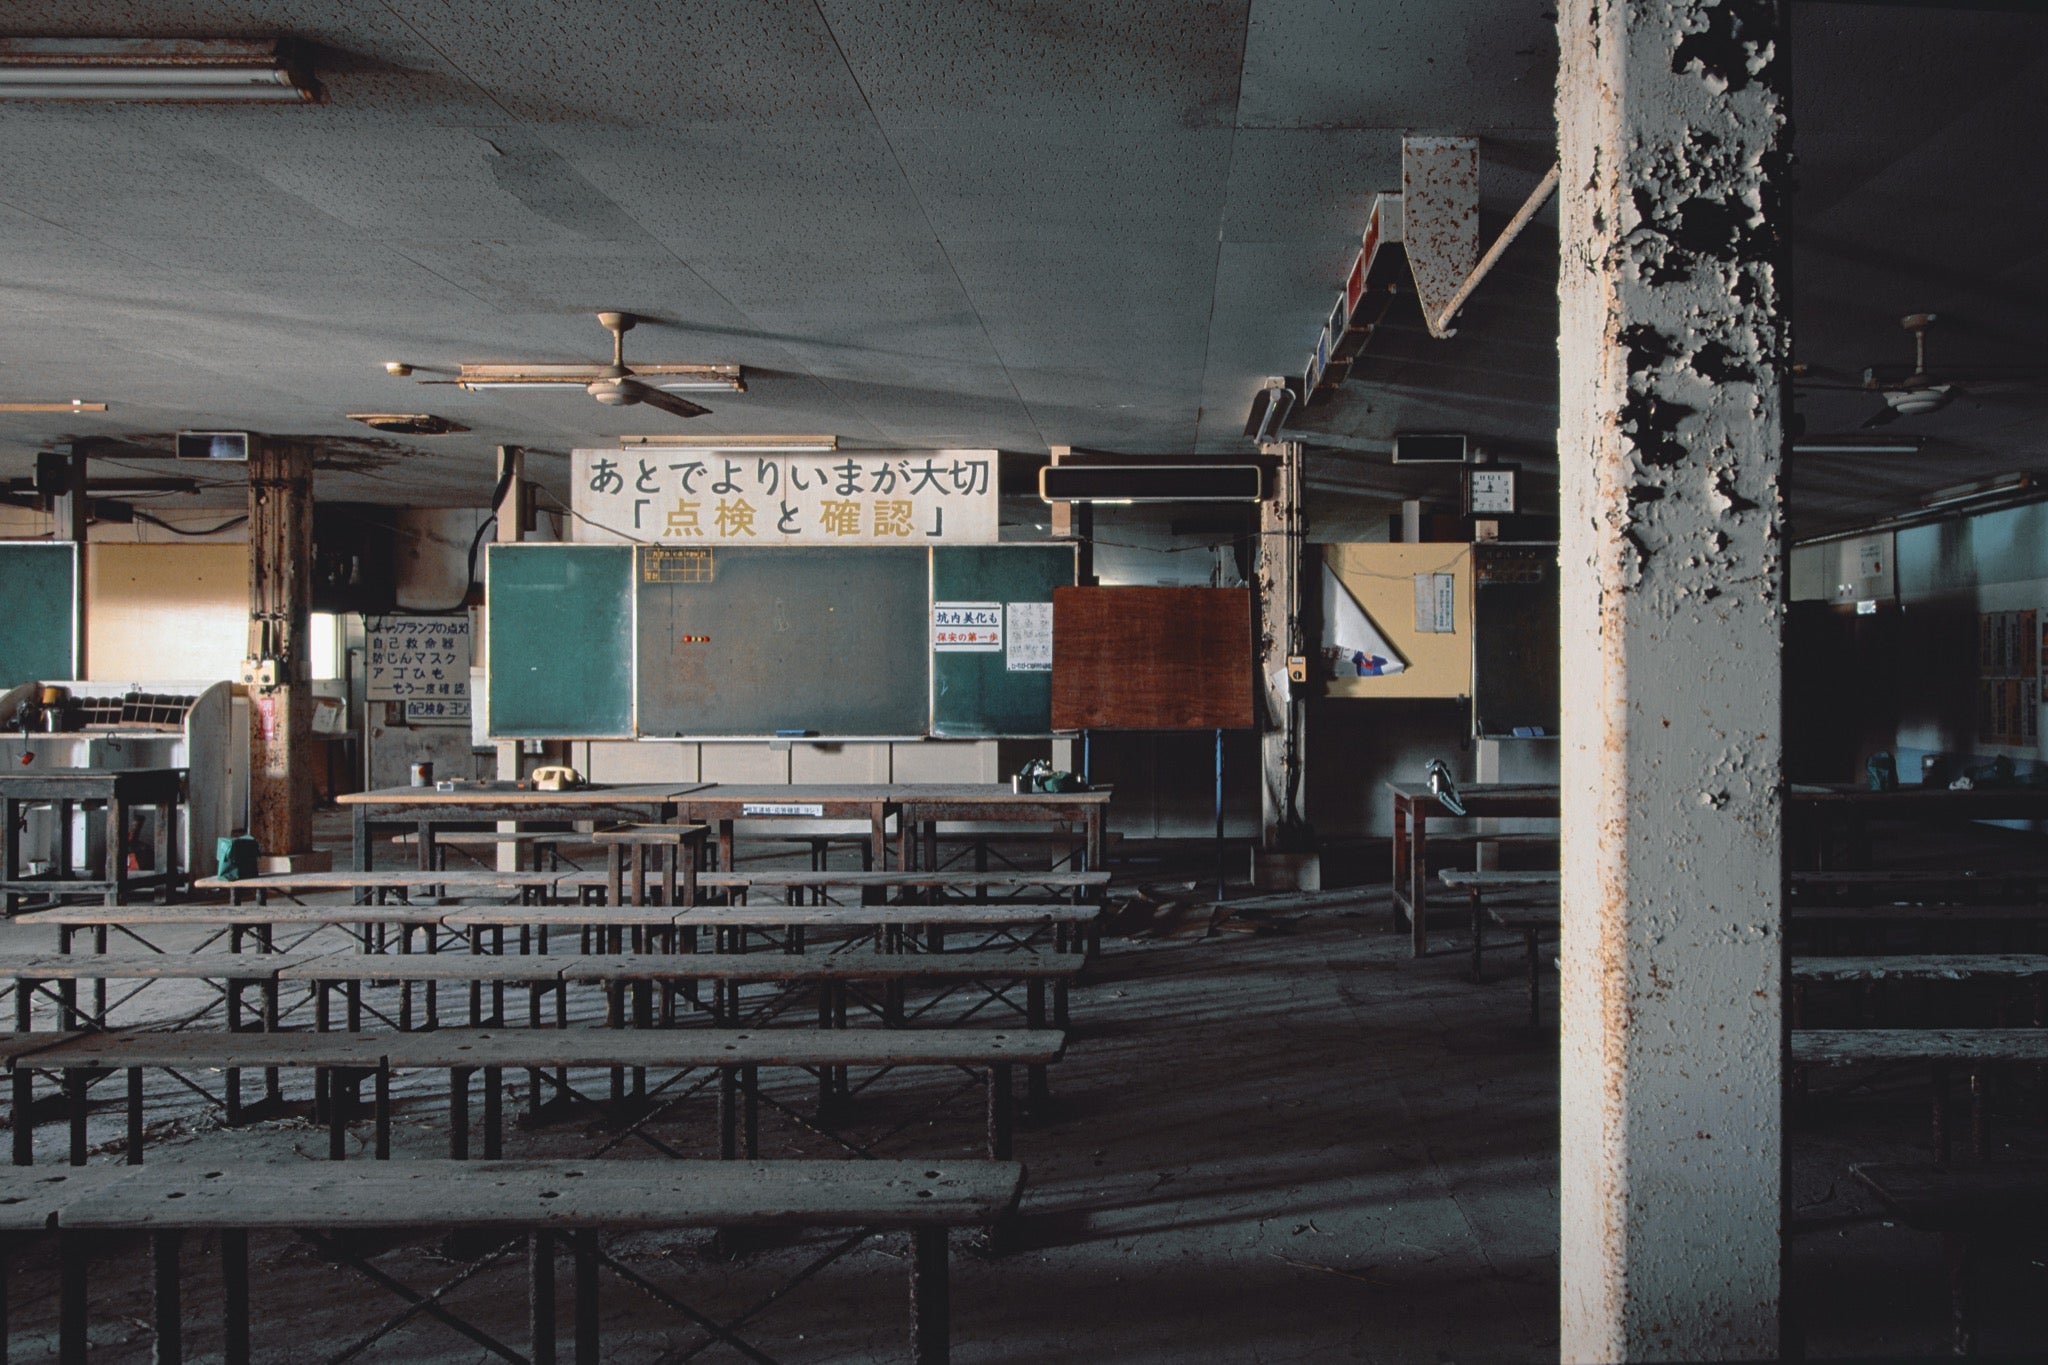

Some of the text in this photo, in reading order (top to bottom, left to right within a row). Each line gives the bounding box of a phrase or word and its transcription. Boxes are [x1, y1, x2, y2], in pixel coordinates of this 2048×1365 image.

[589, 457, 989, 496] あとでよりいまが大切
[634, 498, 943, 537] 「点検と確認」
[936, 611, 998, 624] 坑内美化も
[937, 632, 999, 642] 保安の第一歩
[372, 652, 457, 665] 防じんマスク
[373, 667, 445, 680] アゴひも
